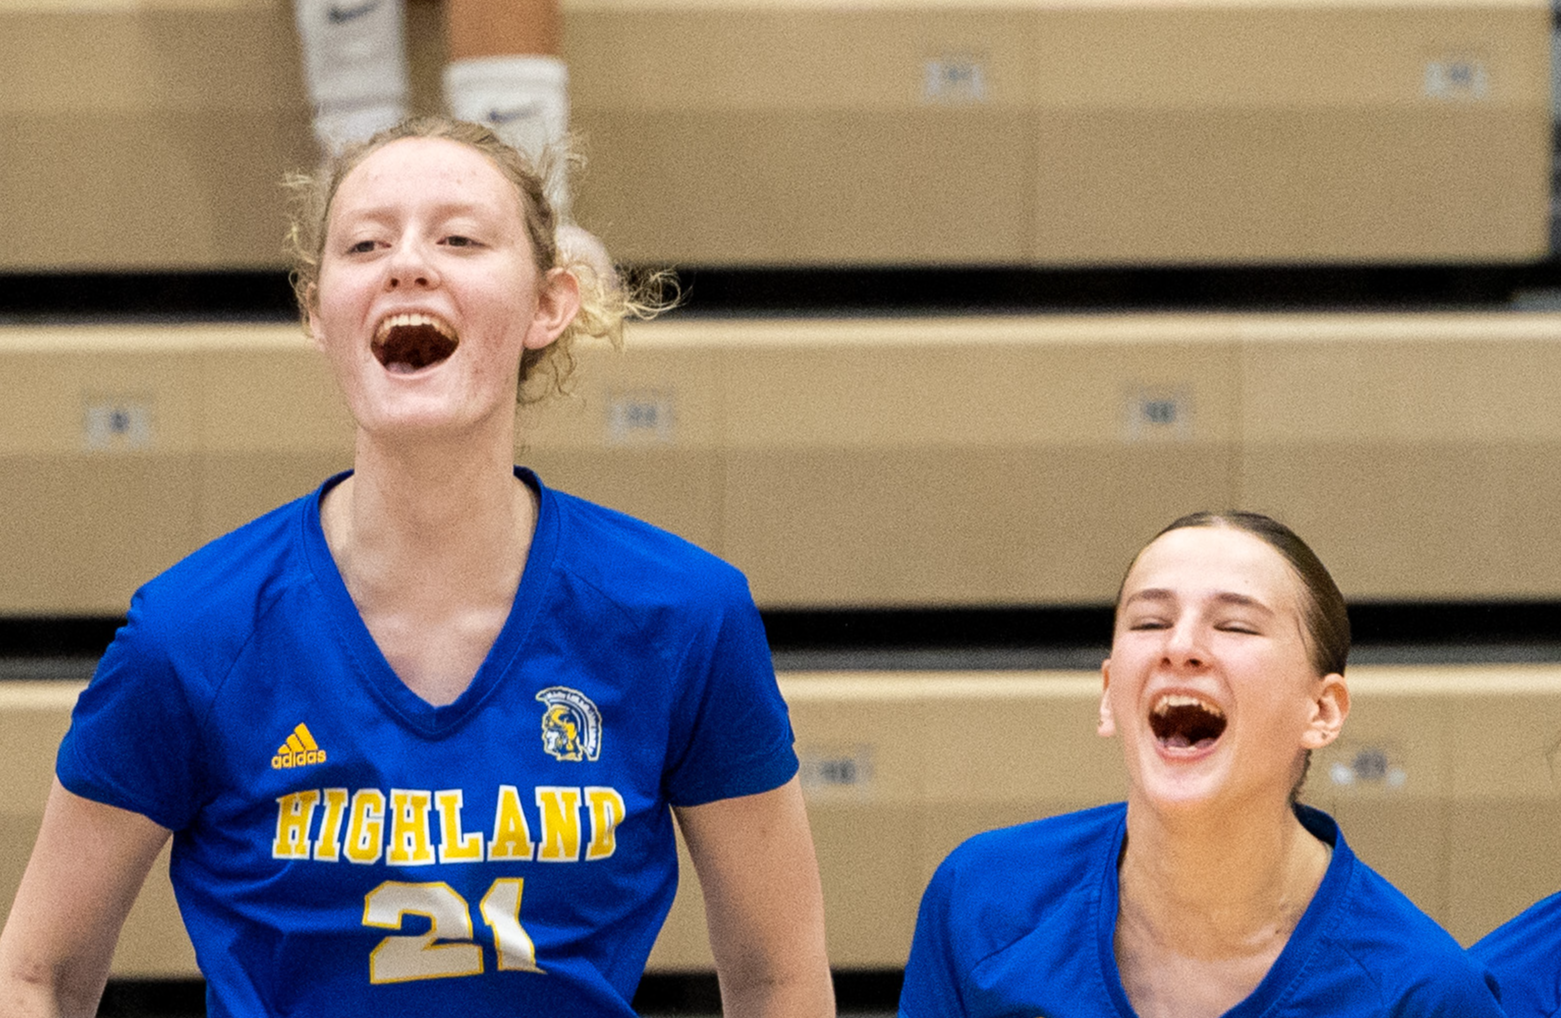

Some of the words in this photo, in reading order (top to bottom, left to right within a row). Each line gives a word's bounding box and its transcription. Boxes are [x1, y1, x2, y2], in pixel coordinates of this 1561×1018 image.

[271, 749, 327, 769] adidas
[272, 785, 626, 866] HIGHLAND
[362, 877, 546, 985] 21
